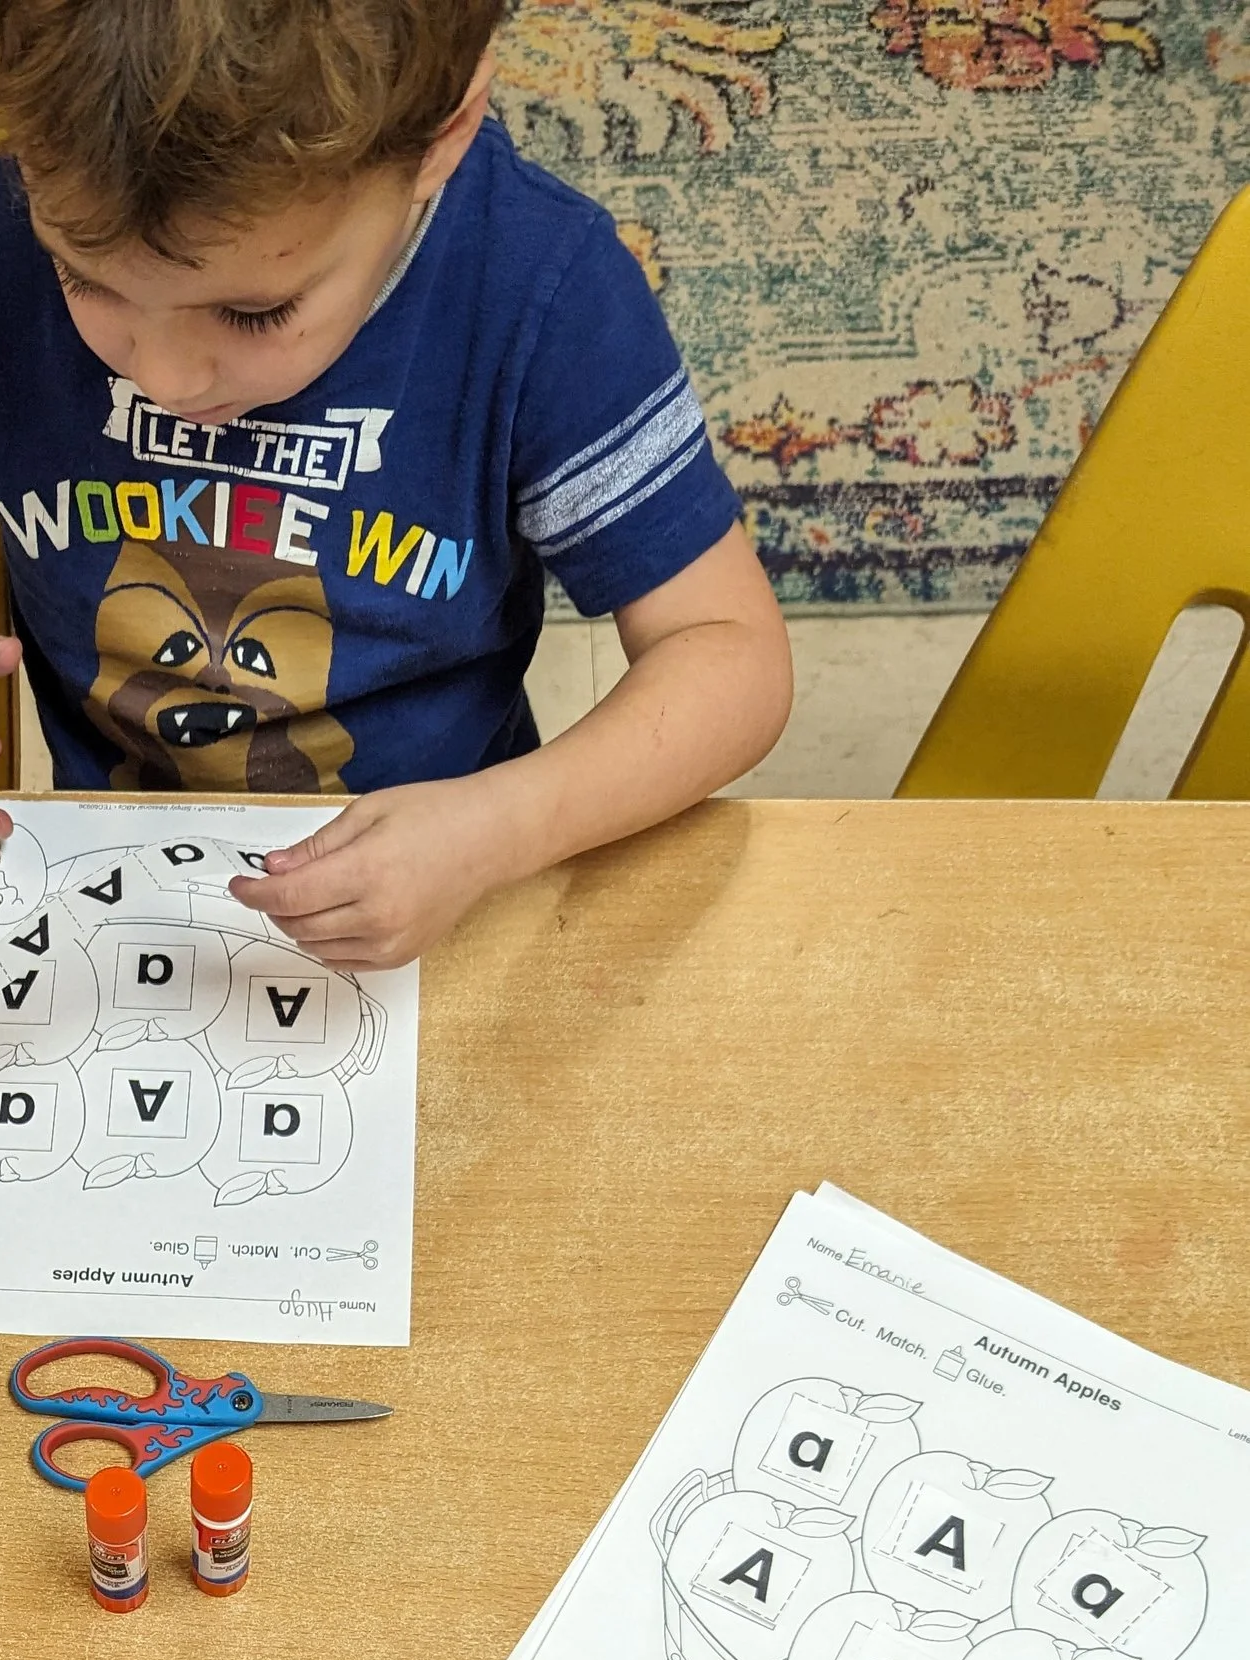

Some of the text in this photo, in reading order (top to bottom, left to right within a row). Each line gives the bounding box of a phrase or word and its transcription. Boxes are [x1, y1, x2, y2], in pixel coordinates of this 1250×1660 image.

[149, 424, 334, 478] LET THE
[346, 509, 474, 600] WIN
[160, 843, 205, 866] a
[78, 866, 123, 905] A
[9, 913, 50, 956] A
[137, 953, 173, 985] a
[265, 986, 311, 1028] A
[129, 1079, 174, 1122] A
[263, 1103, 301, 1138] a
[150, 1241, 190, 1256] Glue.
[228, 1244, 321, 1260] Cut. Match.
[807, 1237, 843, 1262] Name
[52, 1267, 194, 1288] Autumn Apples
[278, 1288, 334, 1322] Hugo
[339, 1301, 377, 1313] Name
[835, 1309, 1006, 1396] Cut. Match. Glue.
[974, 1336, 1123, 1412] Autumn Apples
[787, 1430, 834, 1474] a
[1228, 1428, 1250, 1444] Lette
[914, 1516, 969, 1572] A
[719, 1547, 774, 1604] A
[1071, 1573, 1125, 1620] a
